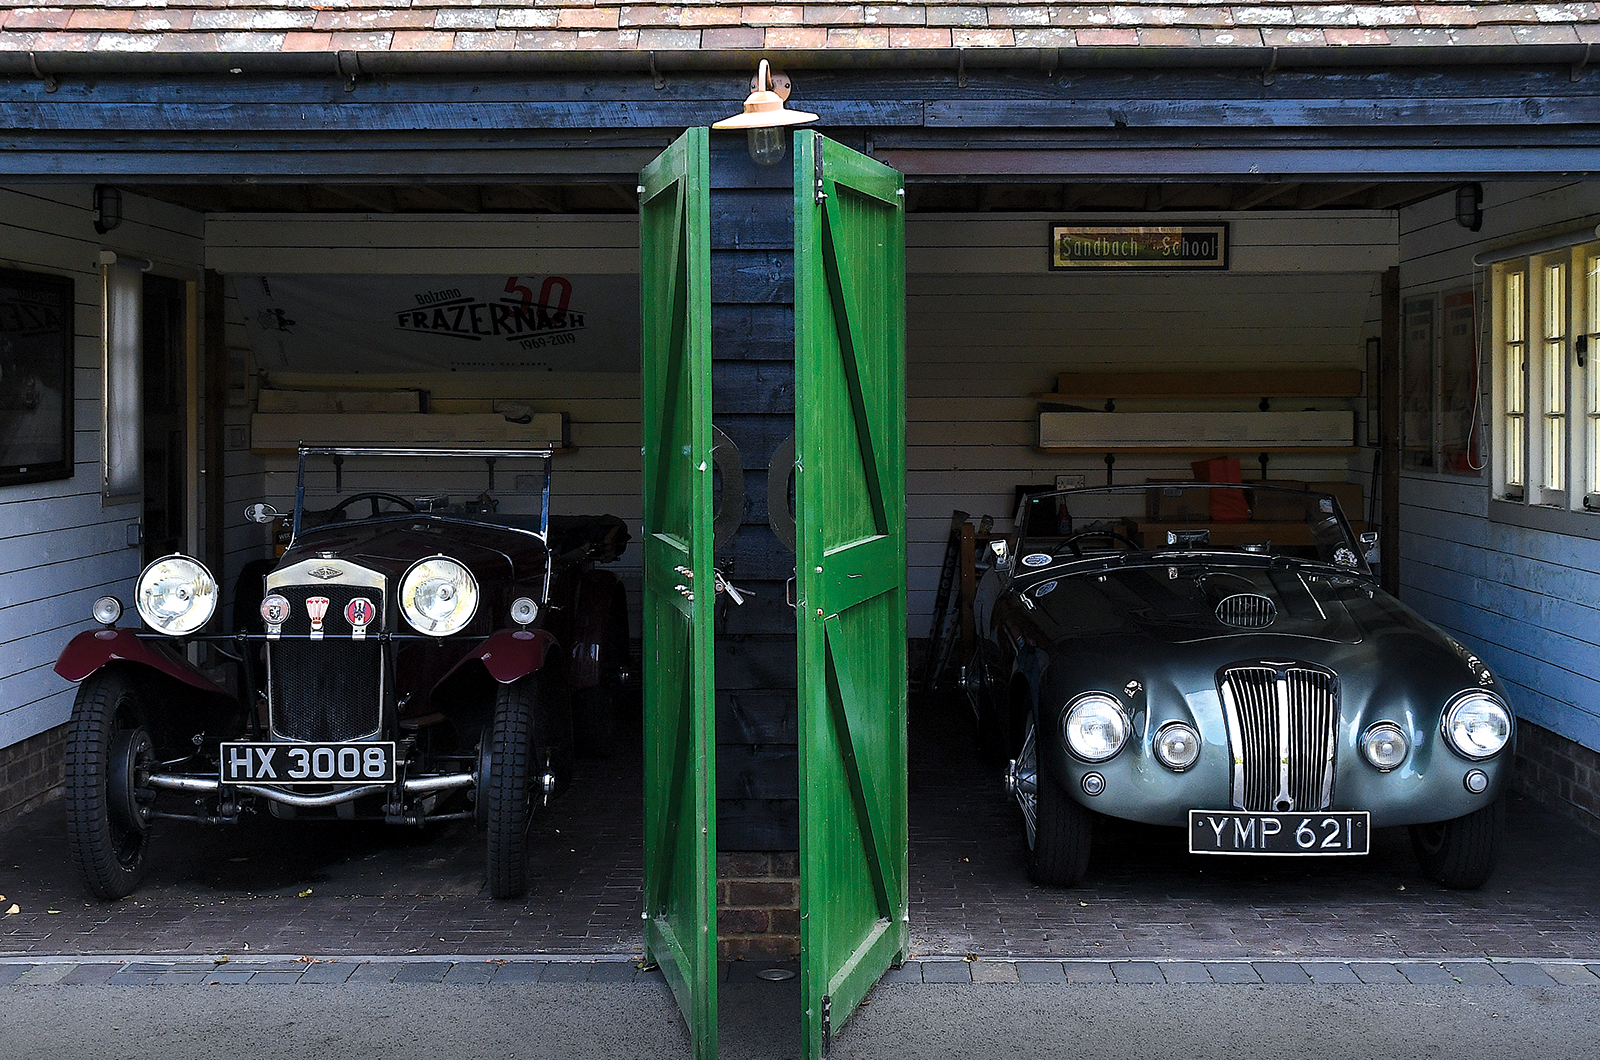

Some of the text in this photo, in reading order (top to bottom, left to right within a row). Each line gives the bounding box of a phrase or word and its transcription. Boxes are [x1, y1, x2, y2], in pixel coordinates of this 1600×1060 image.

[1062, 236, 1215, 257] Sandbach School
[415, 288, 462, 305] Bolzano
[504, 276, 573, 325] 50
[519, 333, 576, 351] 1969-2019
[230, 747, 386, 778] HX 3008
[1206, 816, 1352, 849] YMP 621
